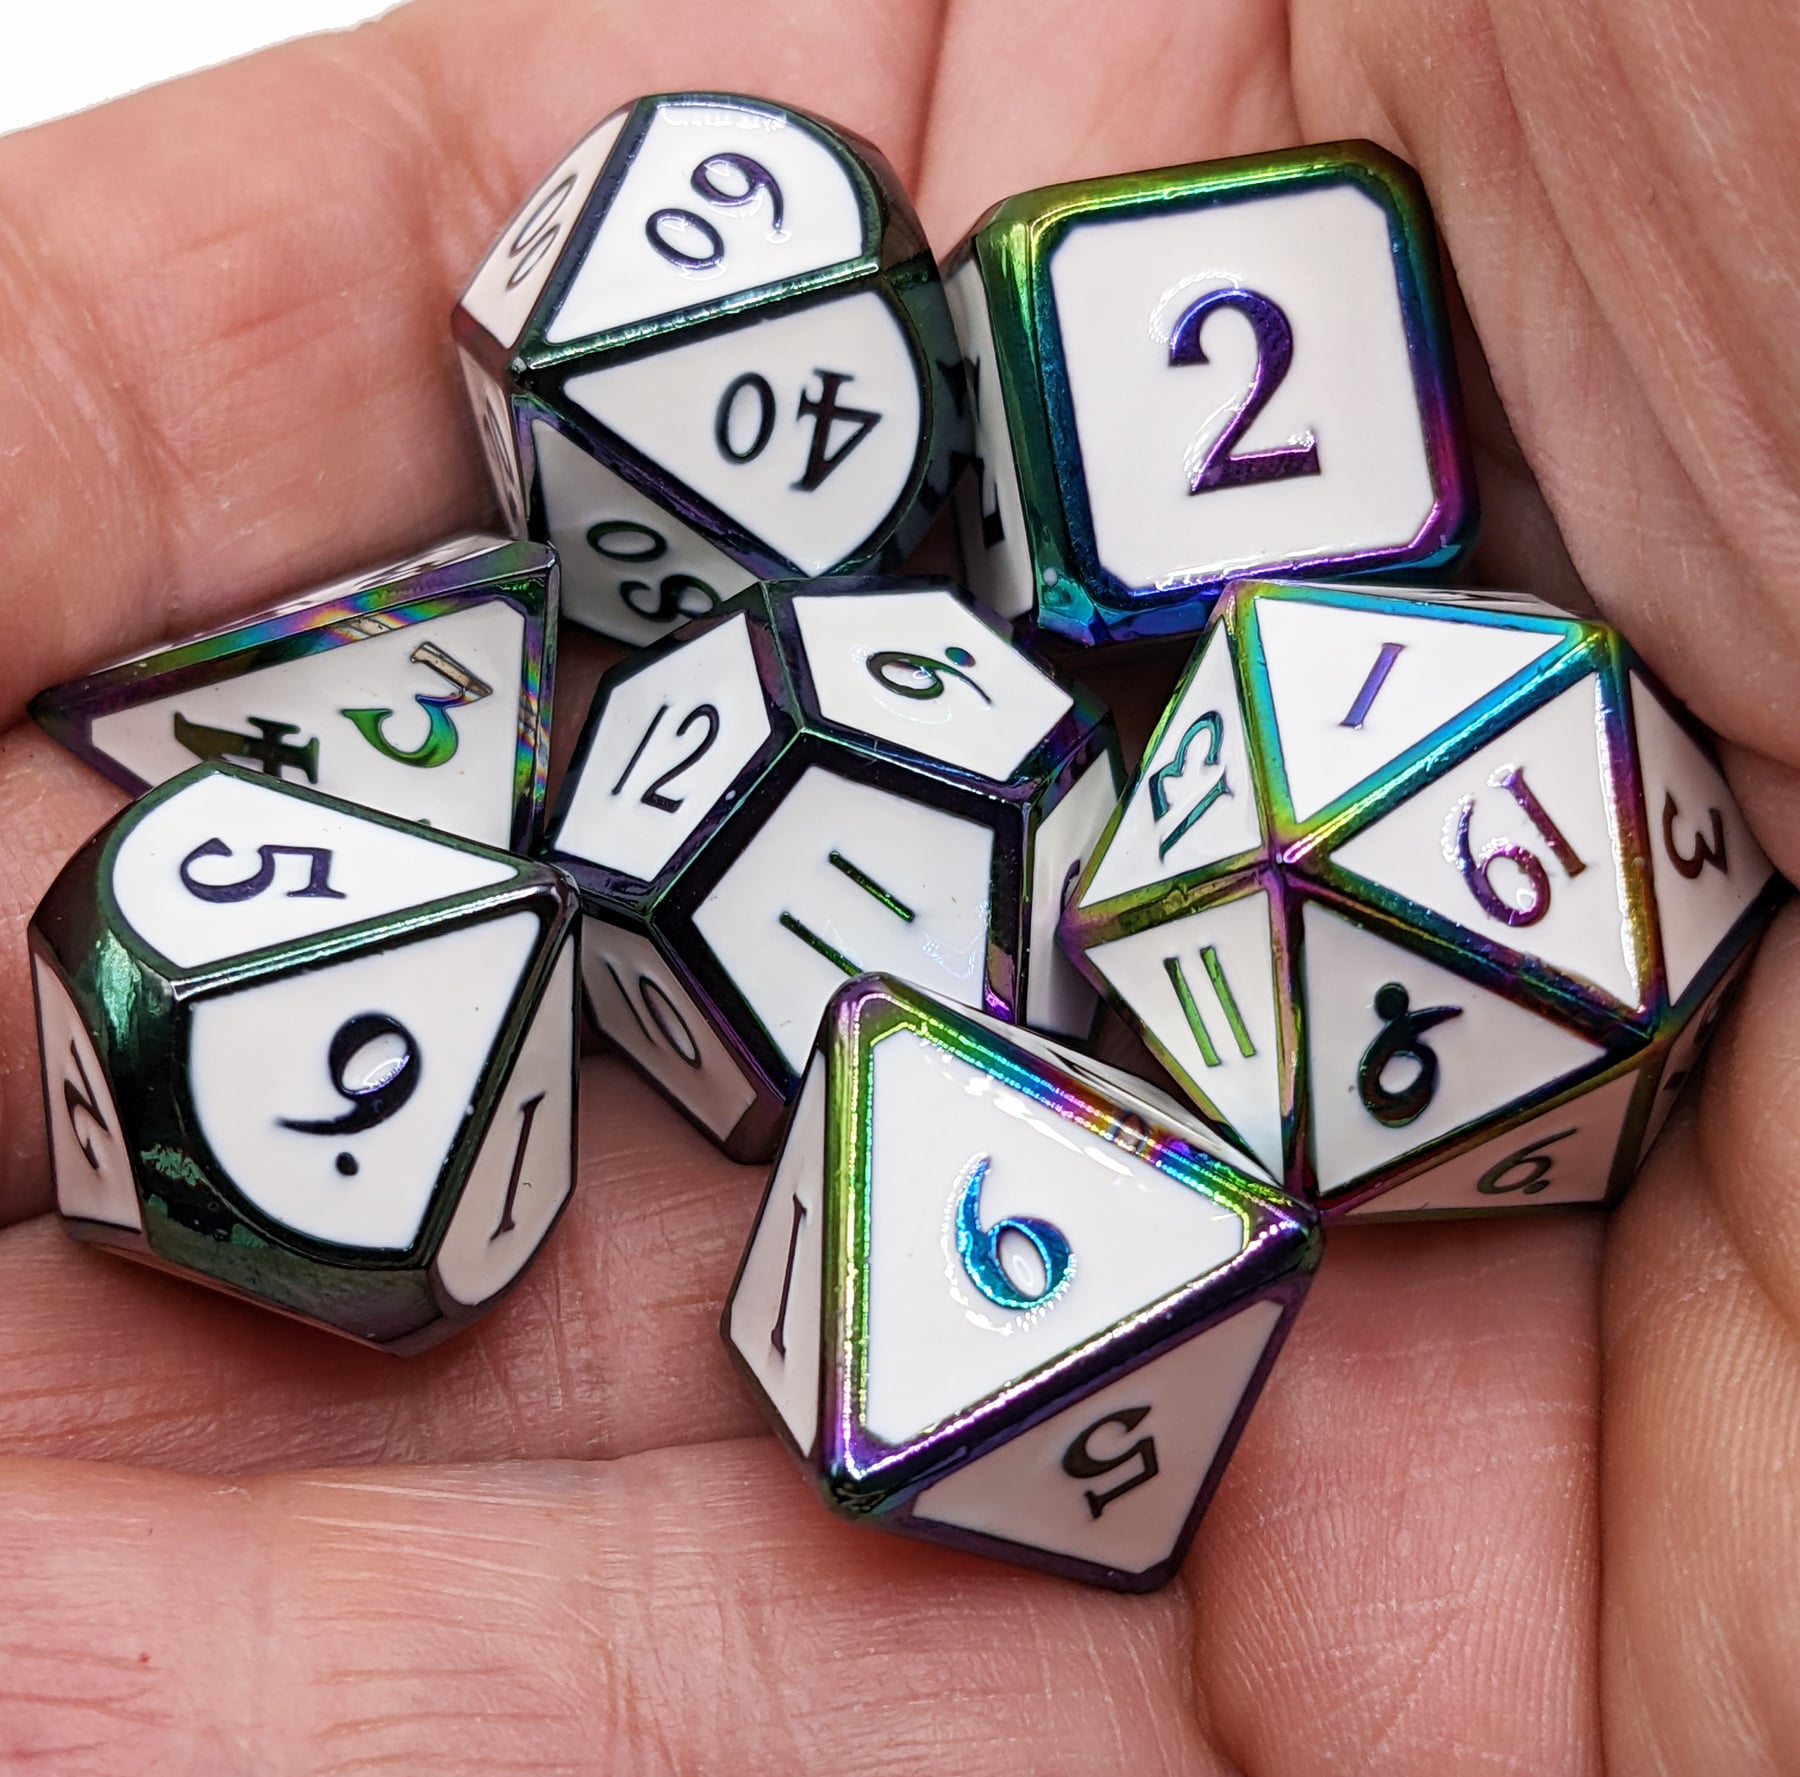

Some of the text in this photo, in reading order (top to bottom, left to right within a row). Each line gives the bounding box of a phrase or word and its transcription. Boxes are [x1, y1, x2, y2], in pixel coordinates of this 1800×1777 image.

[506, 173, 578, 291] 00
[645, 152, 784, 272] 60
[714, 368, 882, 493] 40
[1168, 287, 1322, 497] 2
[586, 519, 720, 621] 80
[340, 641, 493, 768] 3
[1338, 641, 1407, 729] 1
[611, 703, 721, 813] 12
[1151, 710, 1235, 862] 13
[180, 837, 347, 904] 5
[1663, 791, 1730, 882] 3
[779, 849, 915, 977] 11
[605, 957, 701, 1070] 10
[1163, 946, 1258, 1068] 11
[489, 1090, 547, 1243] 1
[771, 1192, 807, 1361] 1
[954, 1152, 1077, 1311] 6
[1061, 1404, 1160, 1521] 5
